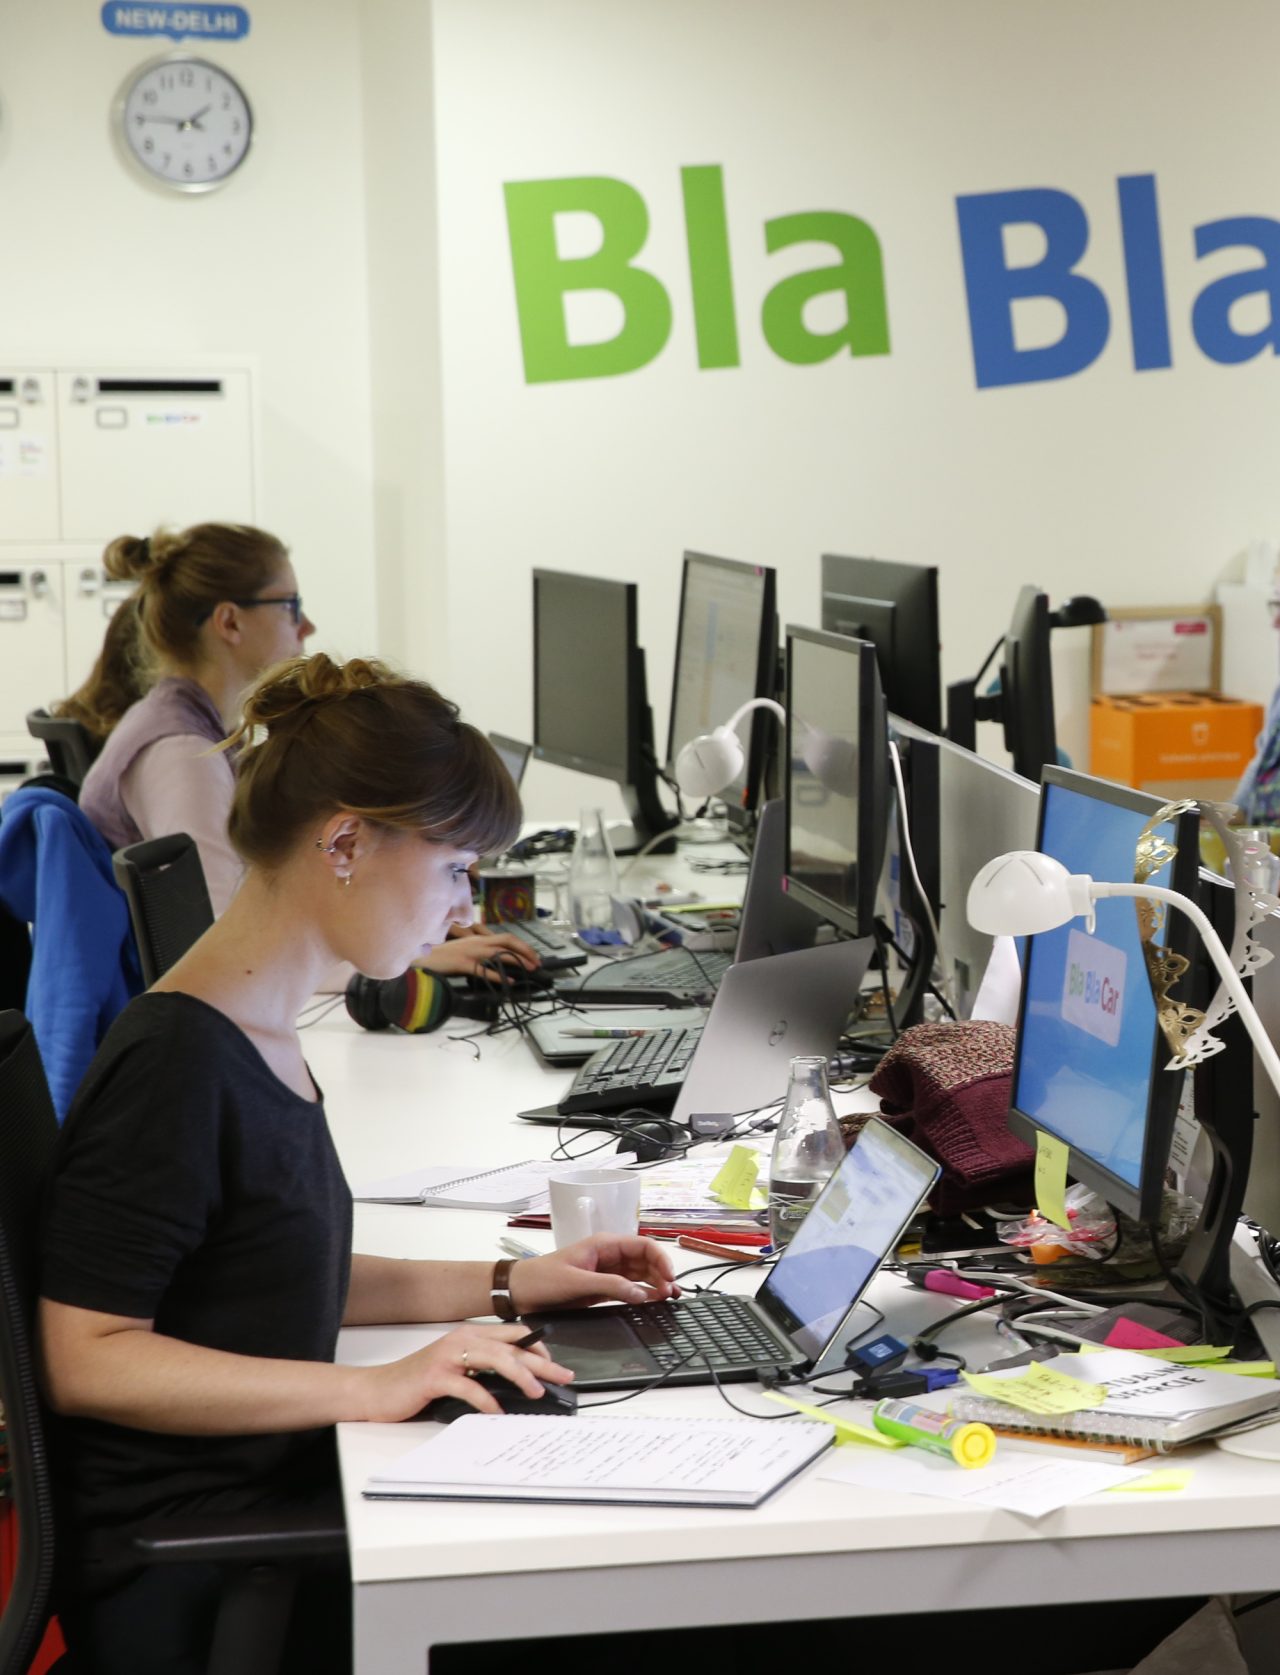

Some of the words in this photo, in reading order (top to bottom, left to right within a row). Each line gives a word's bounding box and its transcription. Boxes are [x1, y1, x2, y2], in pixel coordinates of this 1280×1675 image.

[115, 8, 238, 32] NEW-DELHI
[502, 163, 892, 385] Bla
[1101, 976, 1120, 1016] Car
